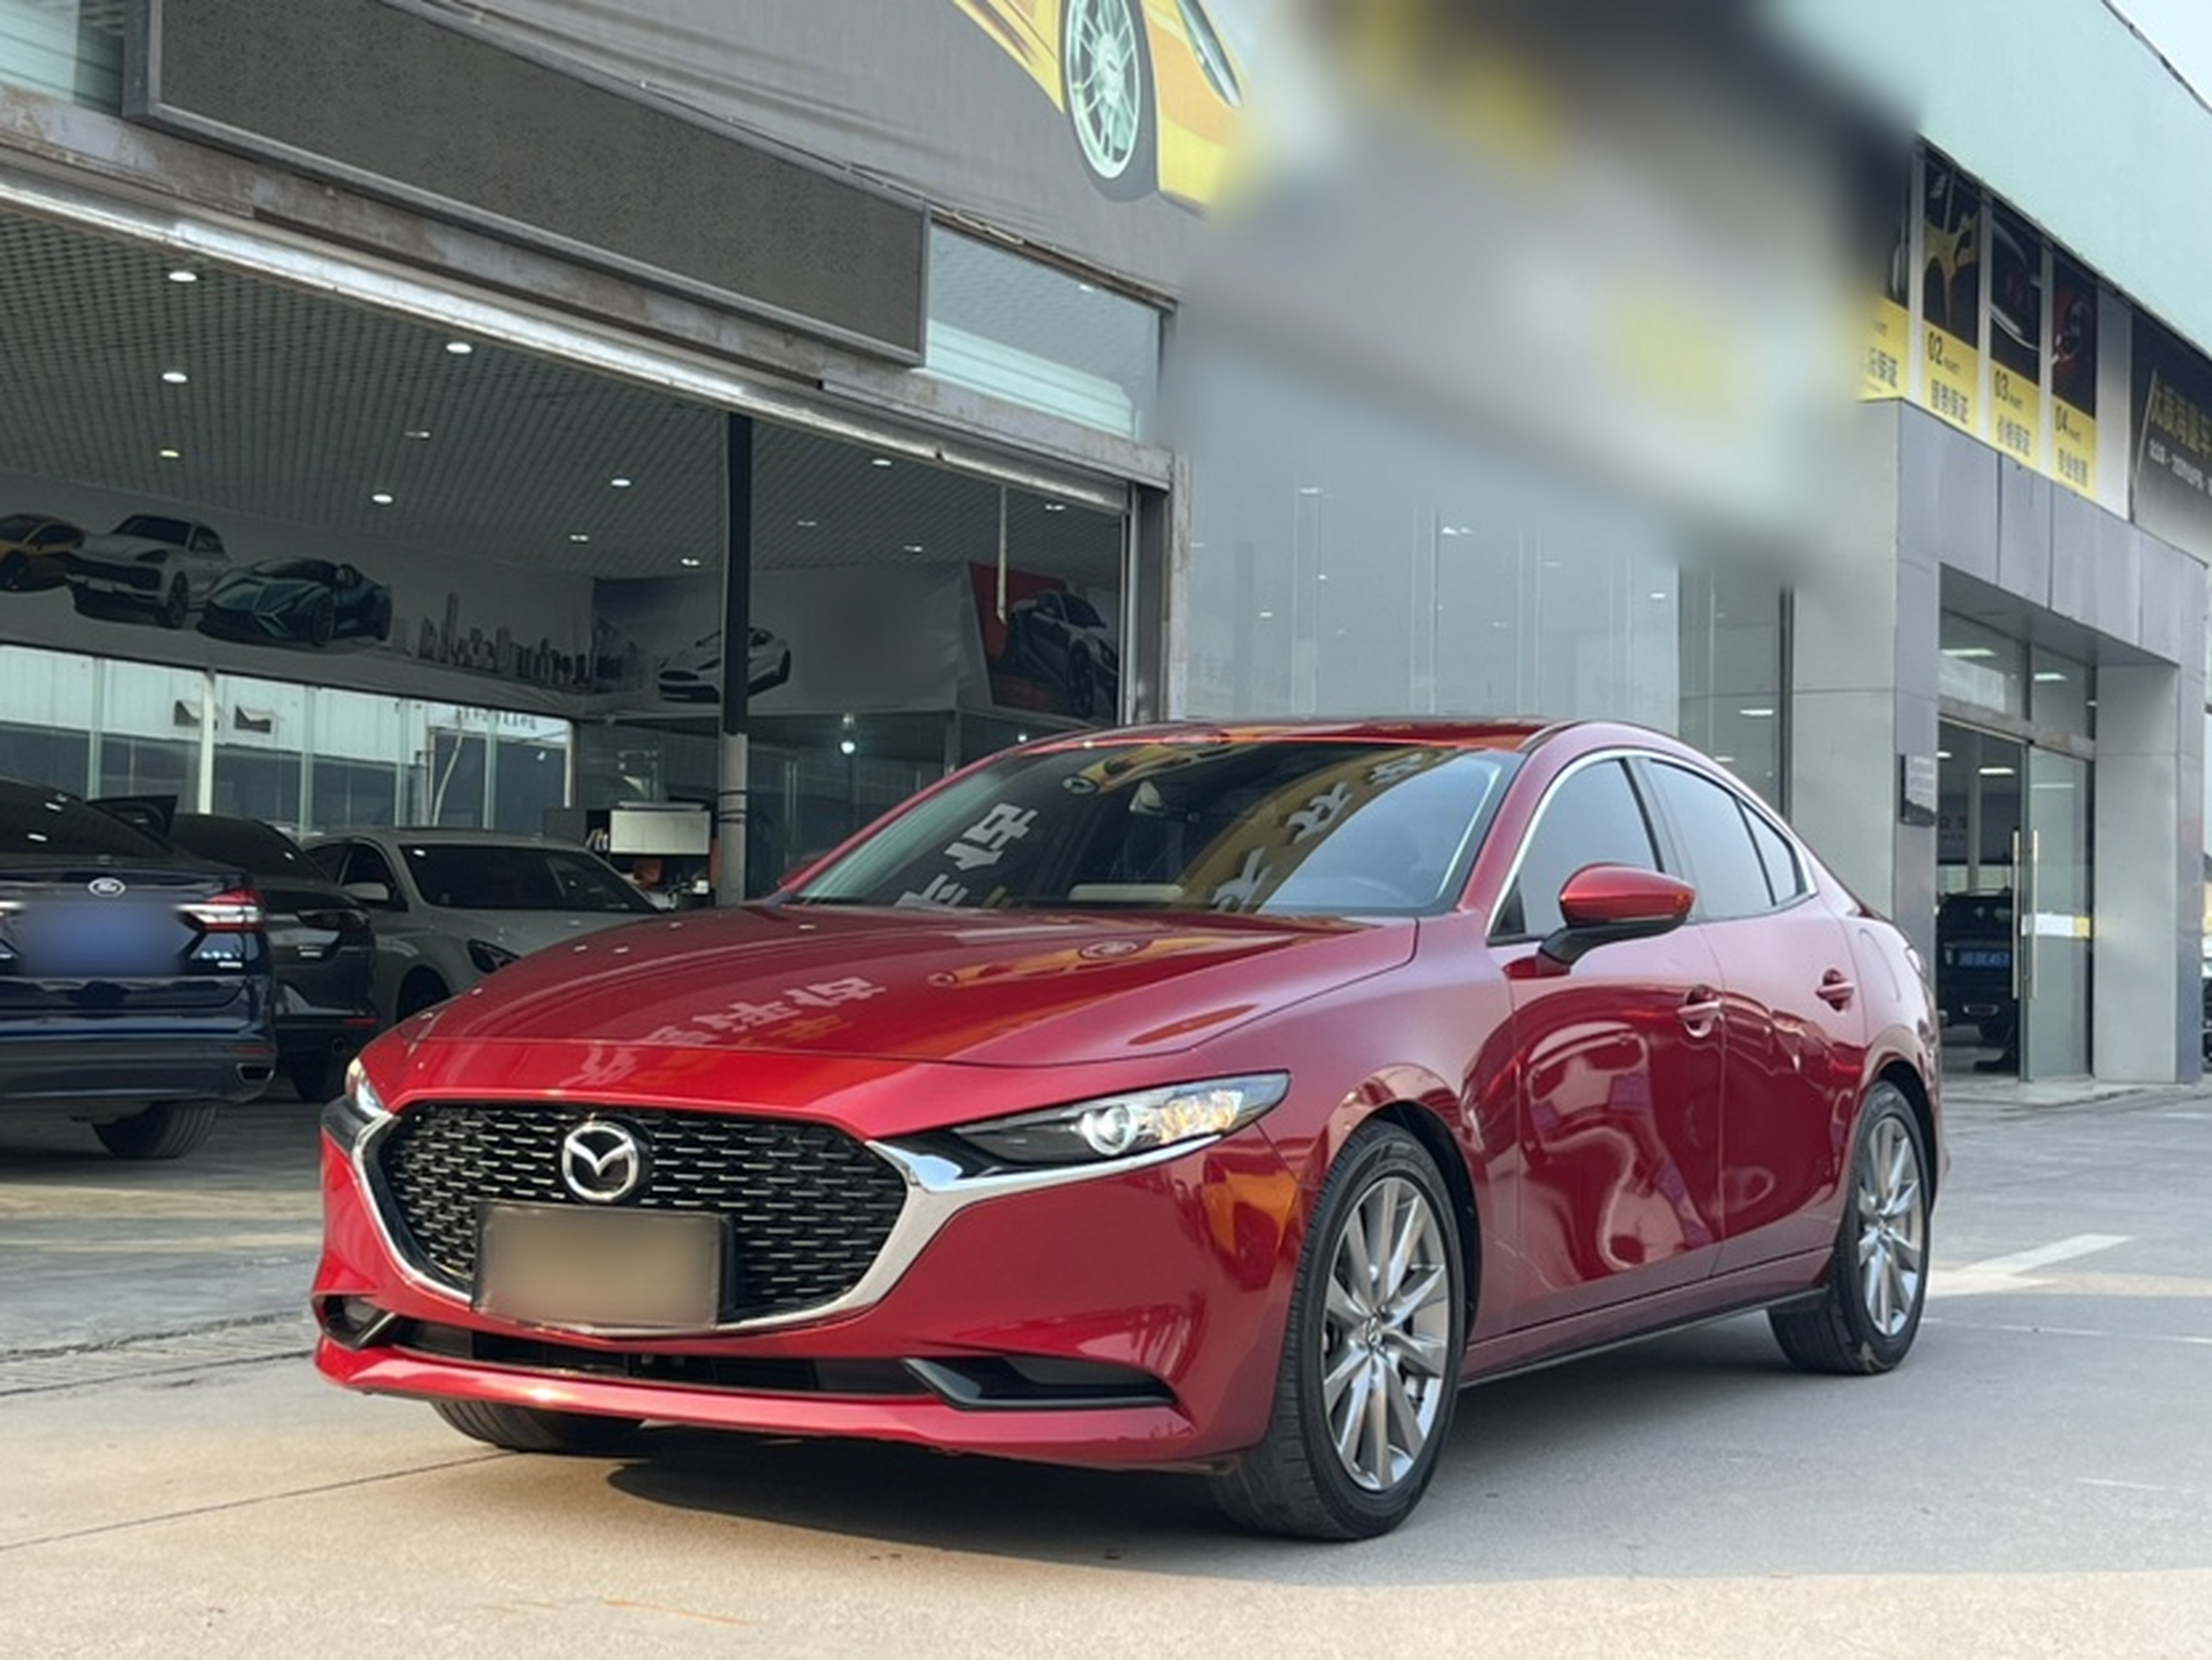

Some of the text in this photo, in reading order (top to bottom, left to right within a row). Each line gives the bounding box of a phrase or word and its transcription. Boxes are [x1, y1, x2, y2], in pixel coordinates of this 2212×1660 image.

[1927, 331, 1942, 365] 02
[1994, 370, 2009, 401] 03
[2055, 404, 2068, 433] 04
